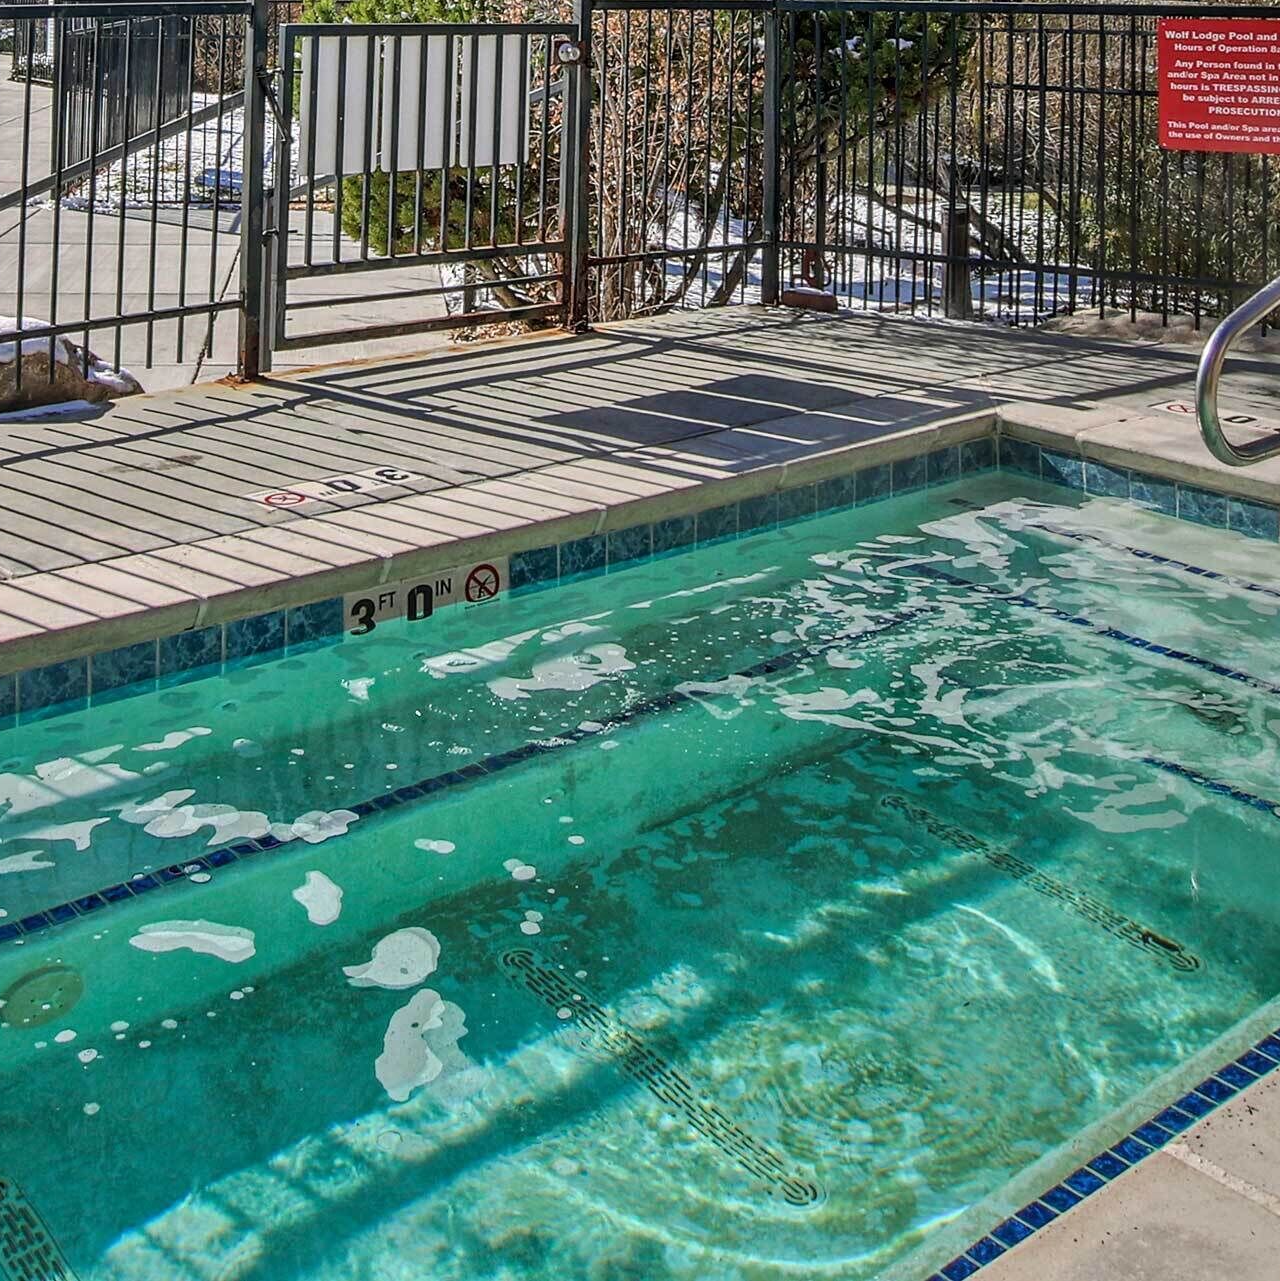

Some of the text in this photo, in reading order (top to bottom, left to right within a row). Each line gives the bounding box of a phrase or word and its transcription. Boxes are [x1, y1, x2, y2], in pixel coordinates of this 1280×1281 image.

[1165, 30, 1189, 39] Wolf
[1191, 31, 1225, 42] Lodge
[1228, 31, 1253, 40] Pool
[1256, 32, 1277, 40] and
[1218, 44, 1268, 54] Operation
[1174, 60, 1194, 69] Any
[1167, 71, 1198, 79] and/or
[1200, 72, 1220, 81] Spa
[1222, 72, 1246, 80] Area
[1200, 83, 1210, 91] is
[1197, 95, 1235, 104] subject
[1167, 121, 1187, 129] This
[1188, 122, 1209, 130] Pool
[1211, 123, 1239, 131] and/or
[1242, 124, 1260, 133] Spa
[1215, 133, 1250, 141] Owners
[1252, 134, 1270, 142] and
[351, 598, 376, 636] 3
[379, 591, 396, 612] FT
[407, 584, 434, 622] 0
[436, 578, 452, 597] IN
